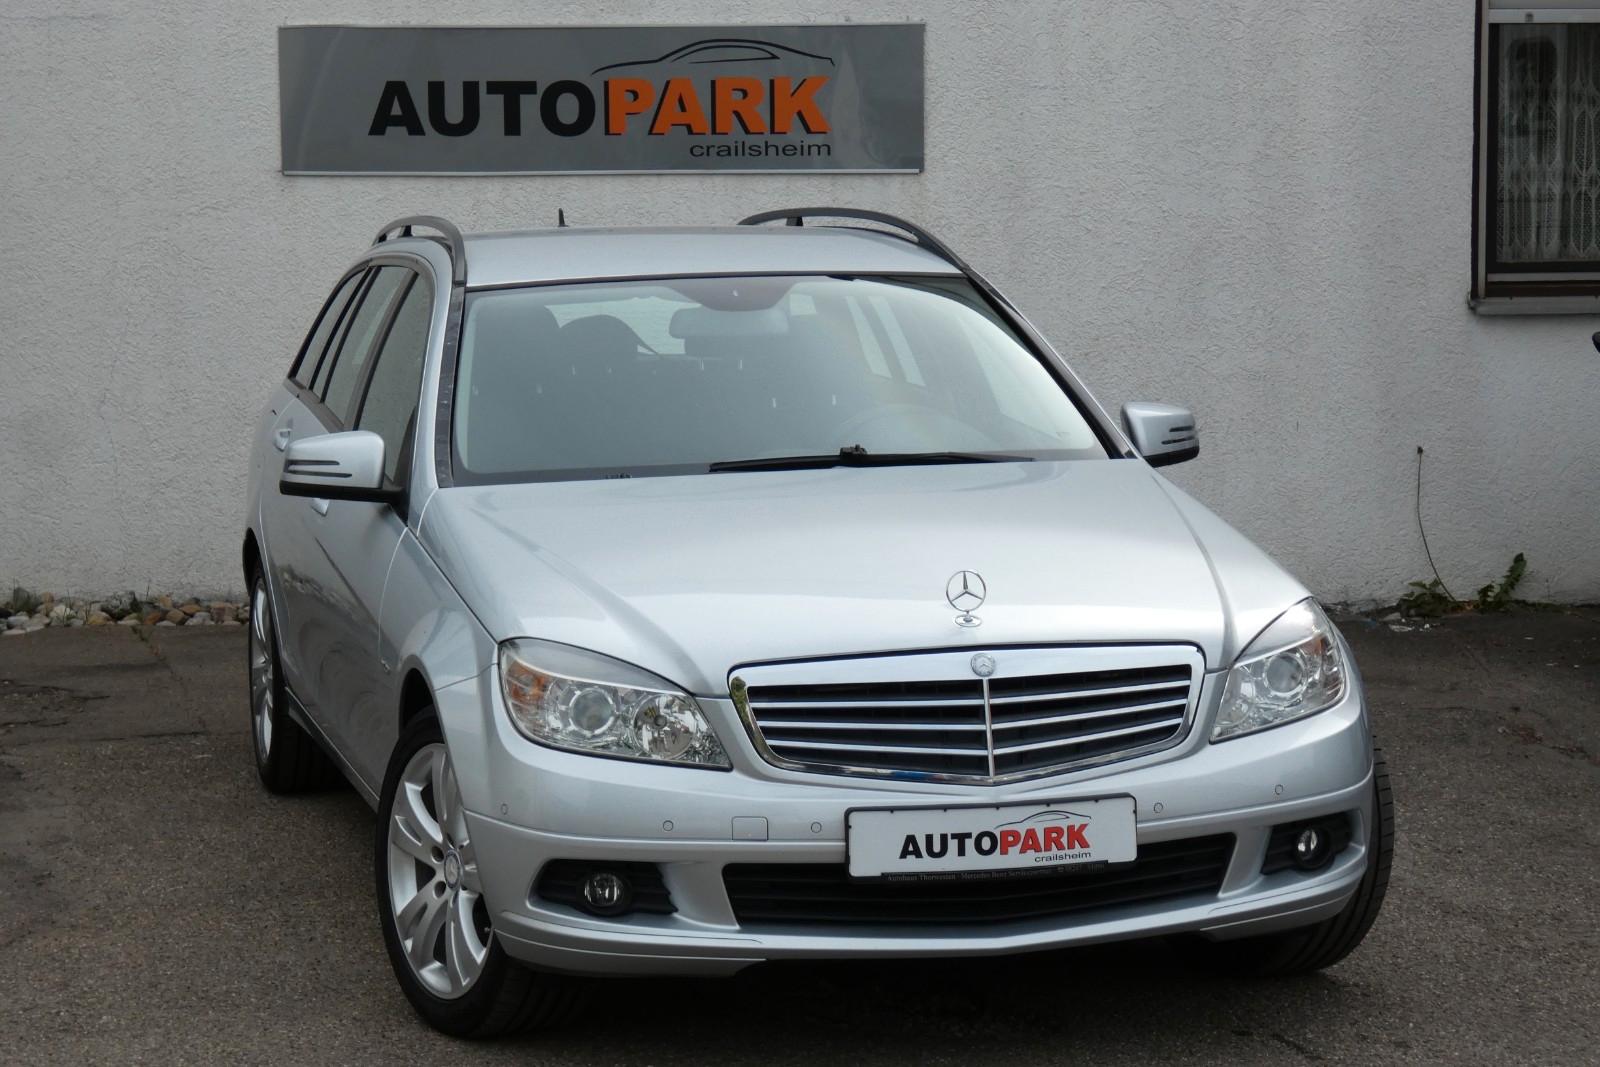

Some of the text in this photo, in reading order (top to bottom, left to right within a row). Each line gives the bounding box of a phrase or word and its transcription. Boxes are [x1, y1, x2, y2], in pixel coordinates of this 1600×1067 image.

[368, 76, 831, 137] AUTOPARK
[688, 139, 832, 160] crailsheim
[898, 823, 1091, 860] AUTOPARK
[1033, 851, 1092, 864] crailsheim
